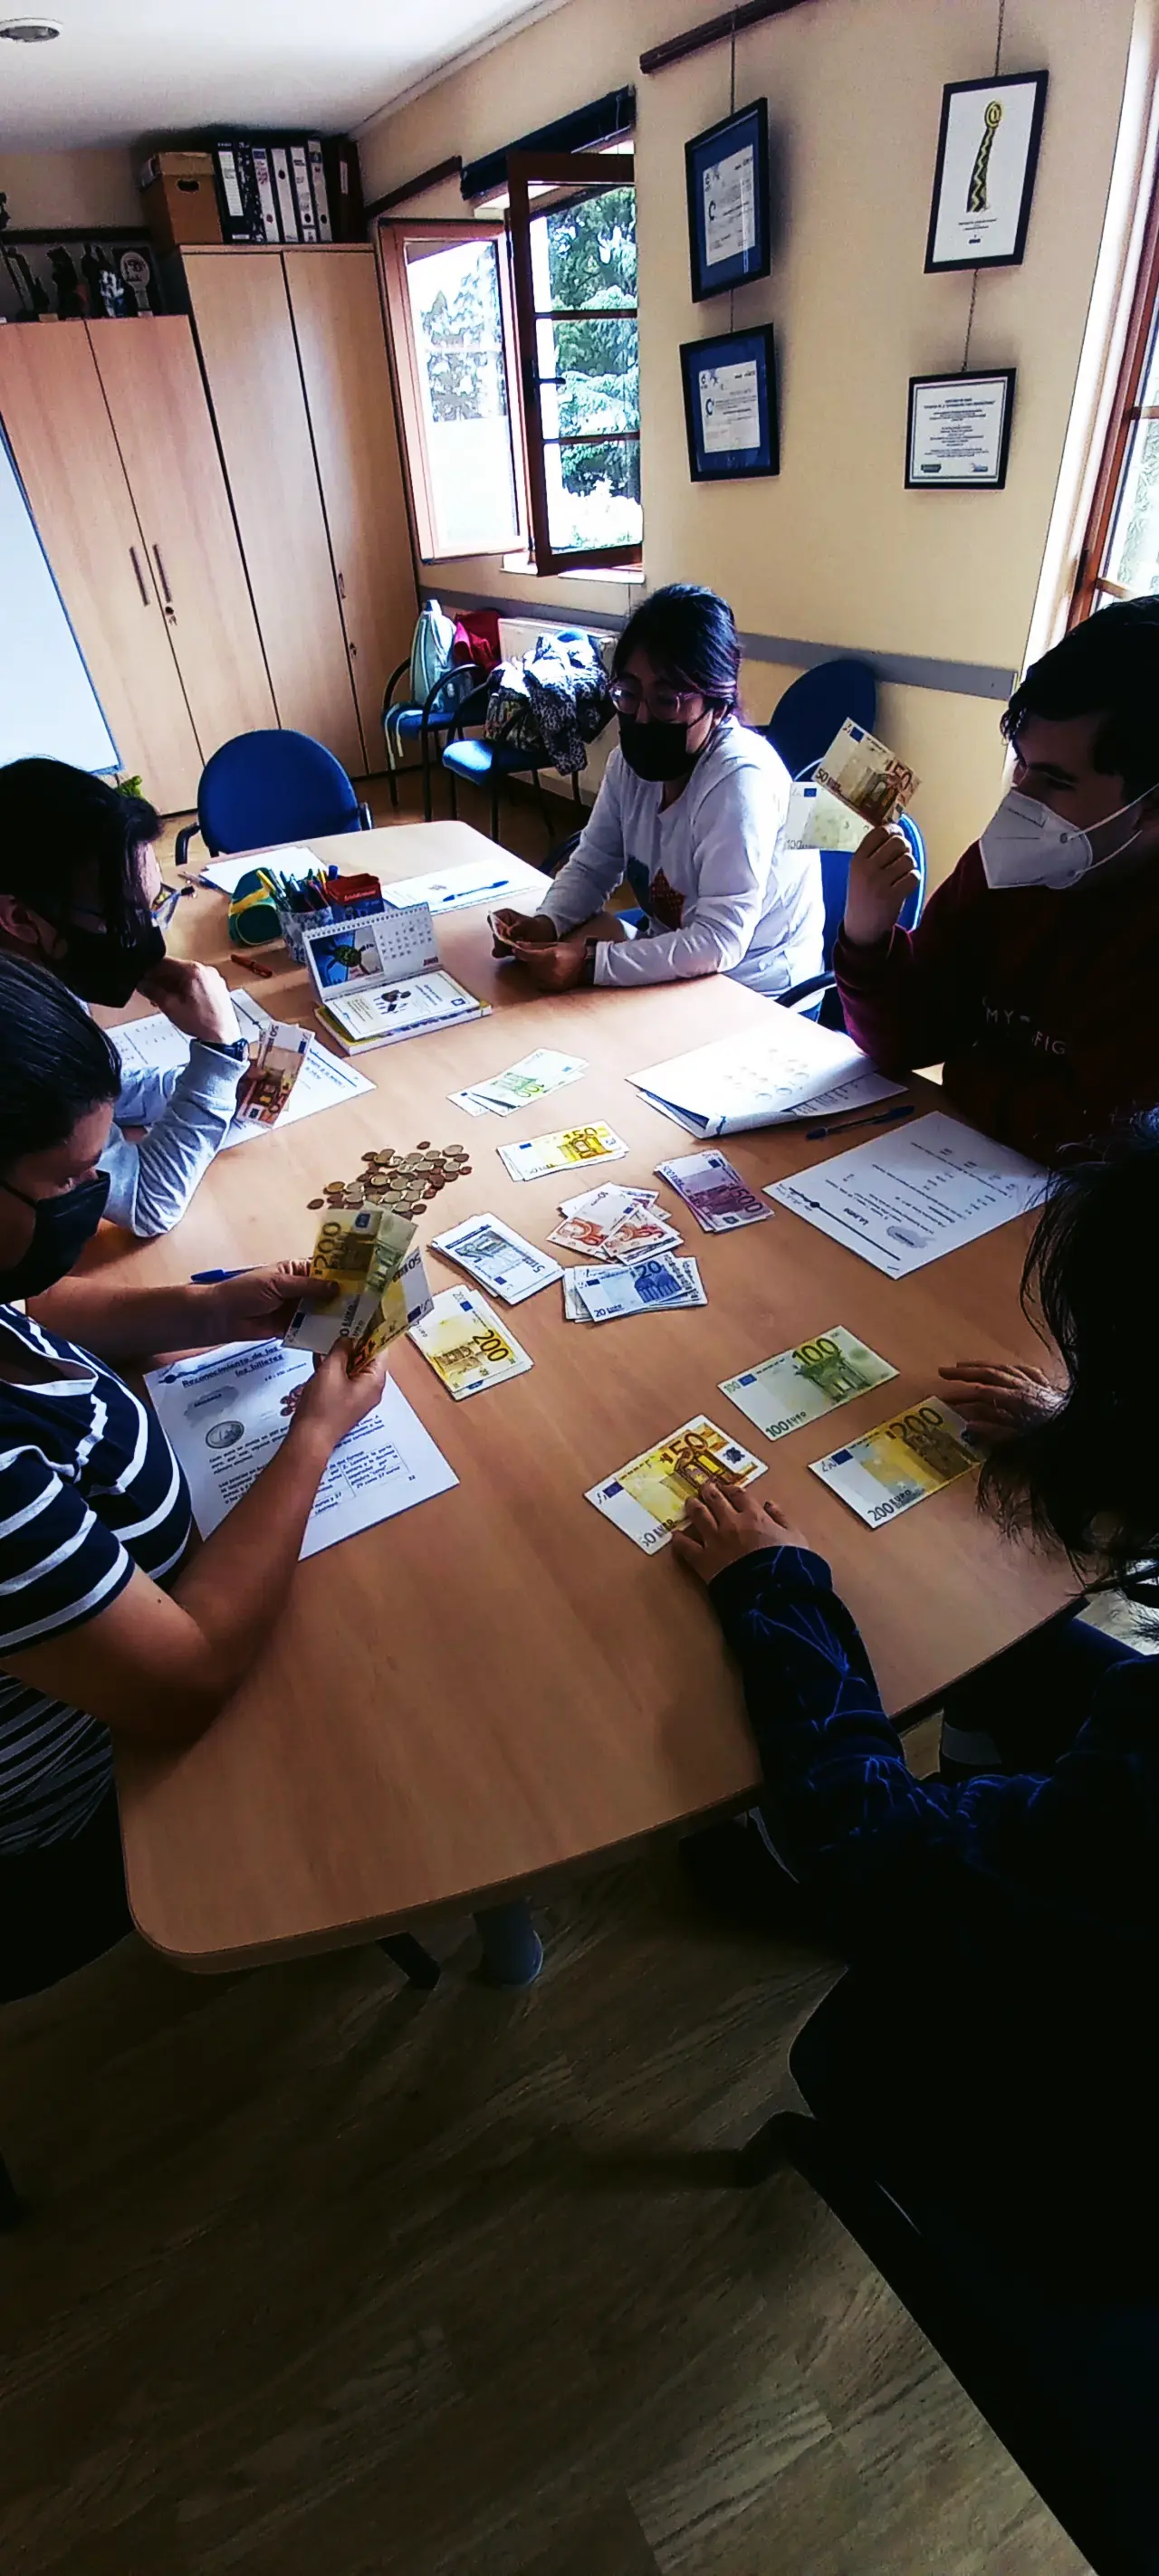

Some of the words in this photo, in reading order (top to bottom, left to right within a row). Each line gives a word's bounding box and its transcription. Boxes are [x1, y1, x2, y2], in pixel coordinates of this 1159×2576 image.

[816, 768, 829, 784] 50
[572, 1127, 598, 1140] 50
[736, 1188, 764, 1213] 500
[407, 1252, 421, 1270] 50
[635, 1260, 662, 1279] 20
[594, 1308, 606, 1318] 20
[472, 1329, 509, 1362] 200
[792, 1336, 840, 1367] 100
[182, 1357, 250, 1388] Reconocimiento
[248, 1354, 284, 1375] billetes
[765, 1419, 789, 1438] 100
[786, 1411, 807, 1427] EURO
[889, 1406, 944, 1437] 200
[668, 1432, 709, 1456] 50
[867, 1501, 895, 1522] 200
[892, 1489, 913, 1510] EURO
